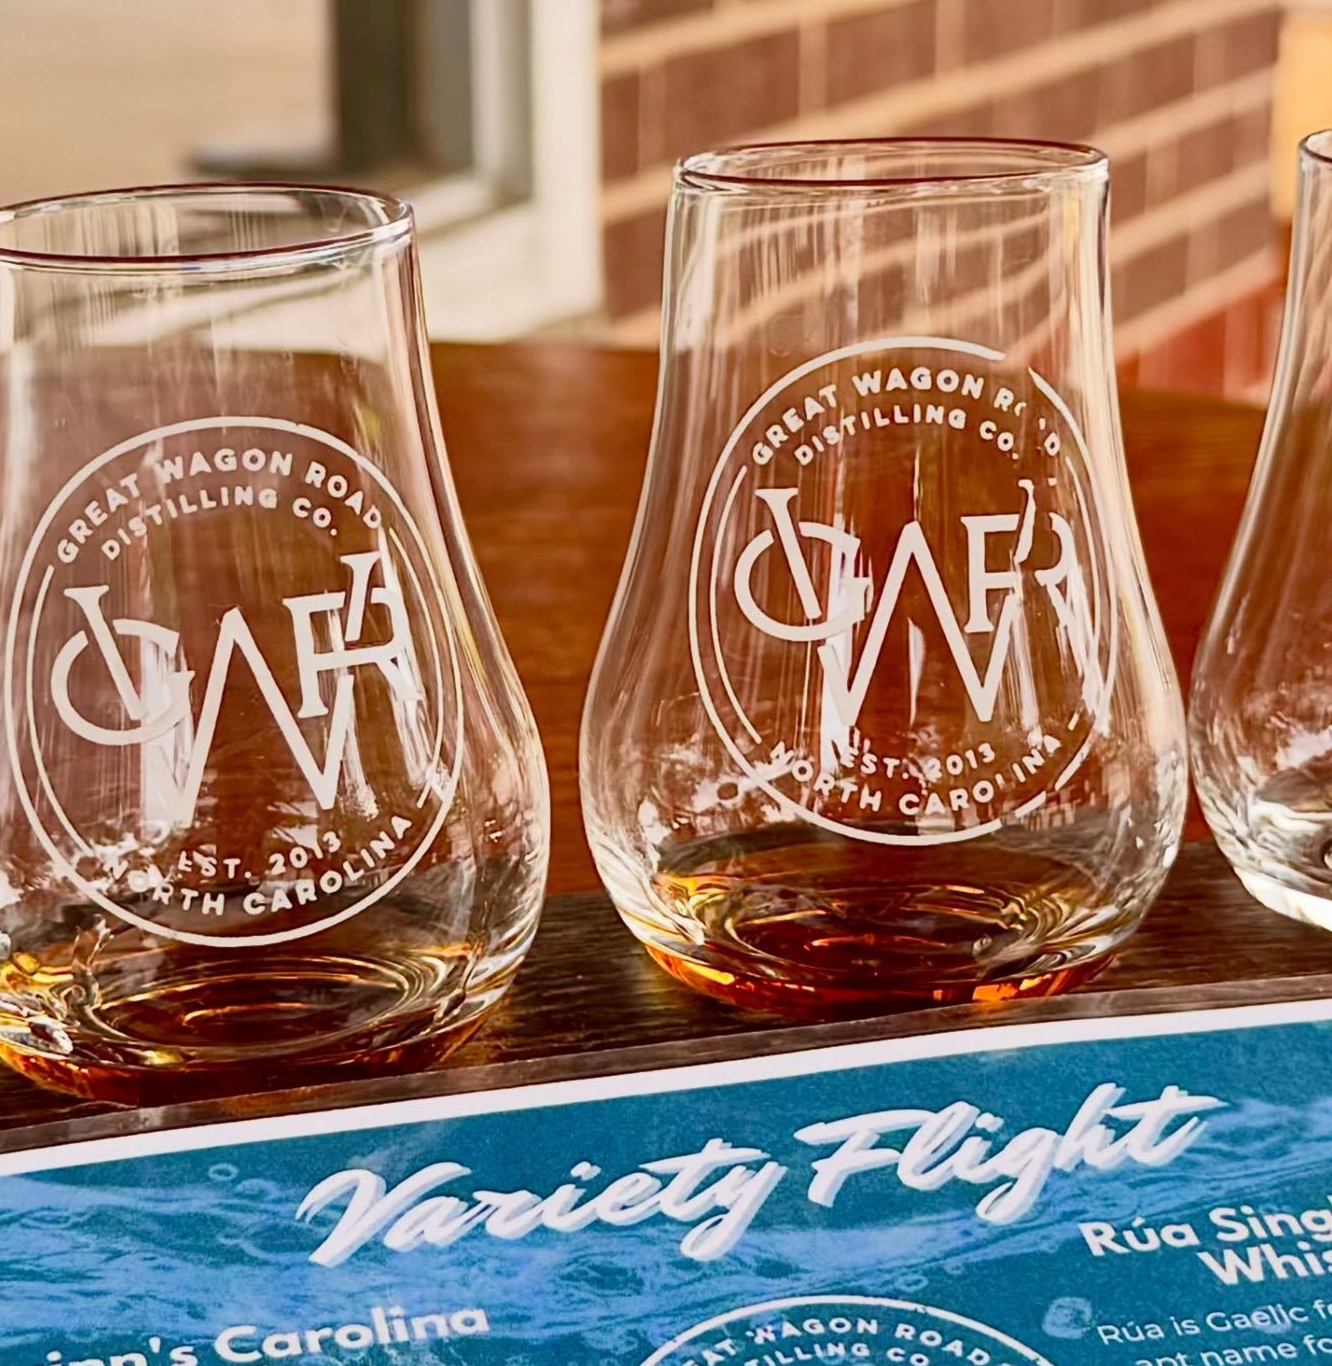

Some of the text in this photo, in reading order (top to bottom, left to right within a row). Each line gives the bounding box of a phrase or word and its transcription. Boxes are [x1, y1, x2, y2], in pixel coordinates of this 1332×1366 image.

[752, 384, 838, 466] GREAT
[851, 366, 985, 400] WAGON
[793, 403, 1020, 467] DISTILLING CO.
[56, 447, 383, 564] GREAT WAGON ROAD
[100, 485, 339, 561] DISTILLING CO.
[839, 742, 996, 783] EST. 2013
[177, 850, 253, 880] EST.
[242, 814, 413, 916] CAROLINA
[296, 1082, 1229, 1268] Variety Flight
[1075, 1213, 1202, 1258] Rúa
[212, 1301, 491, 1364] Carolina
[745, 1317, 879, 1346] WAGON
